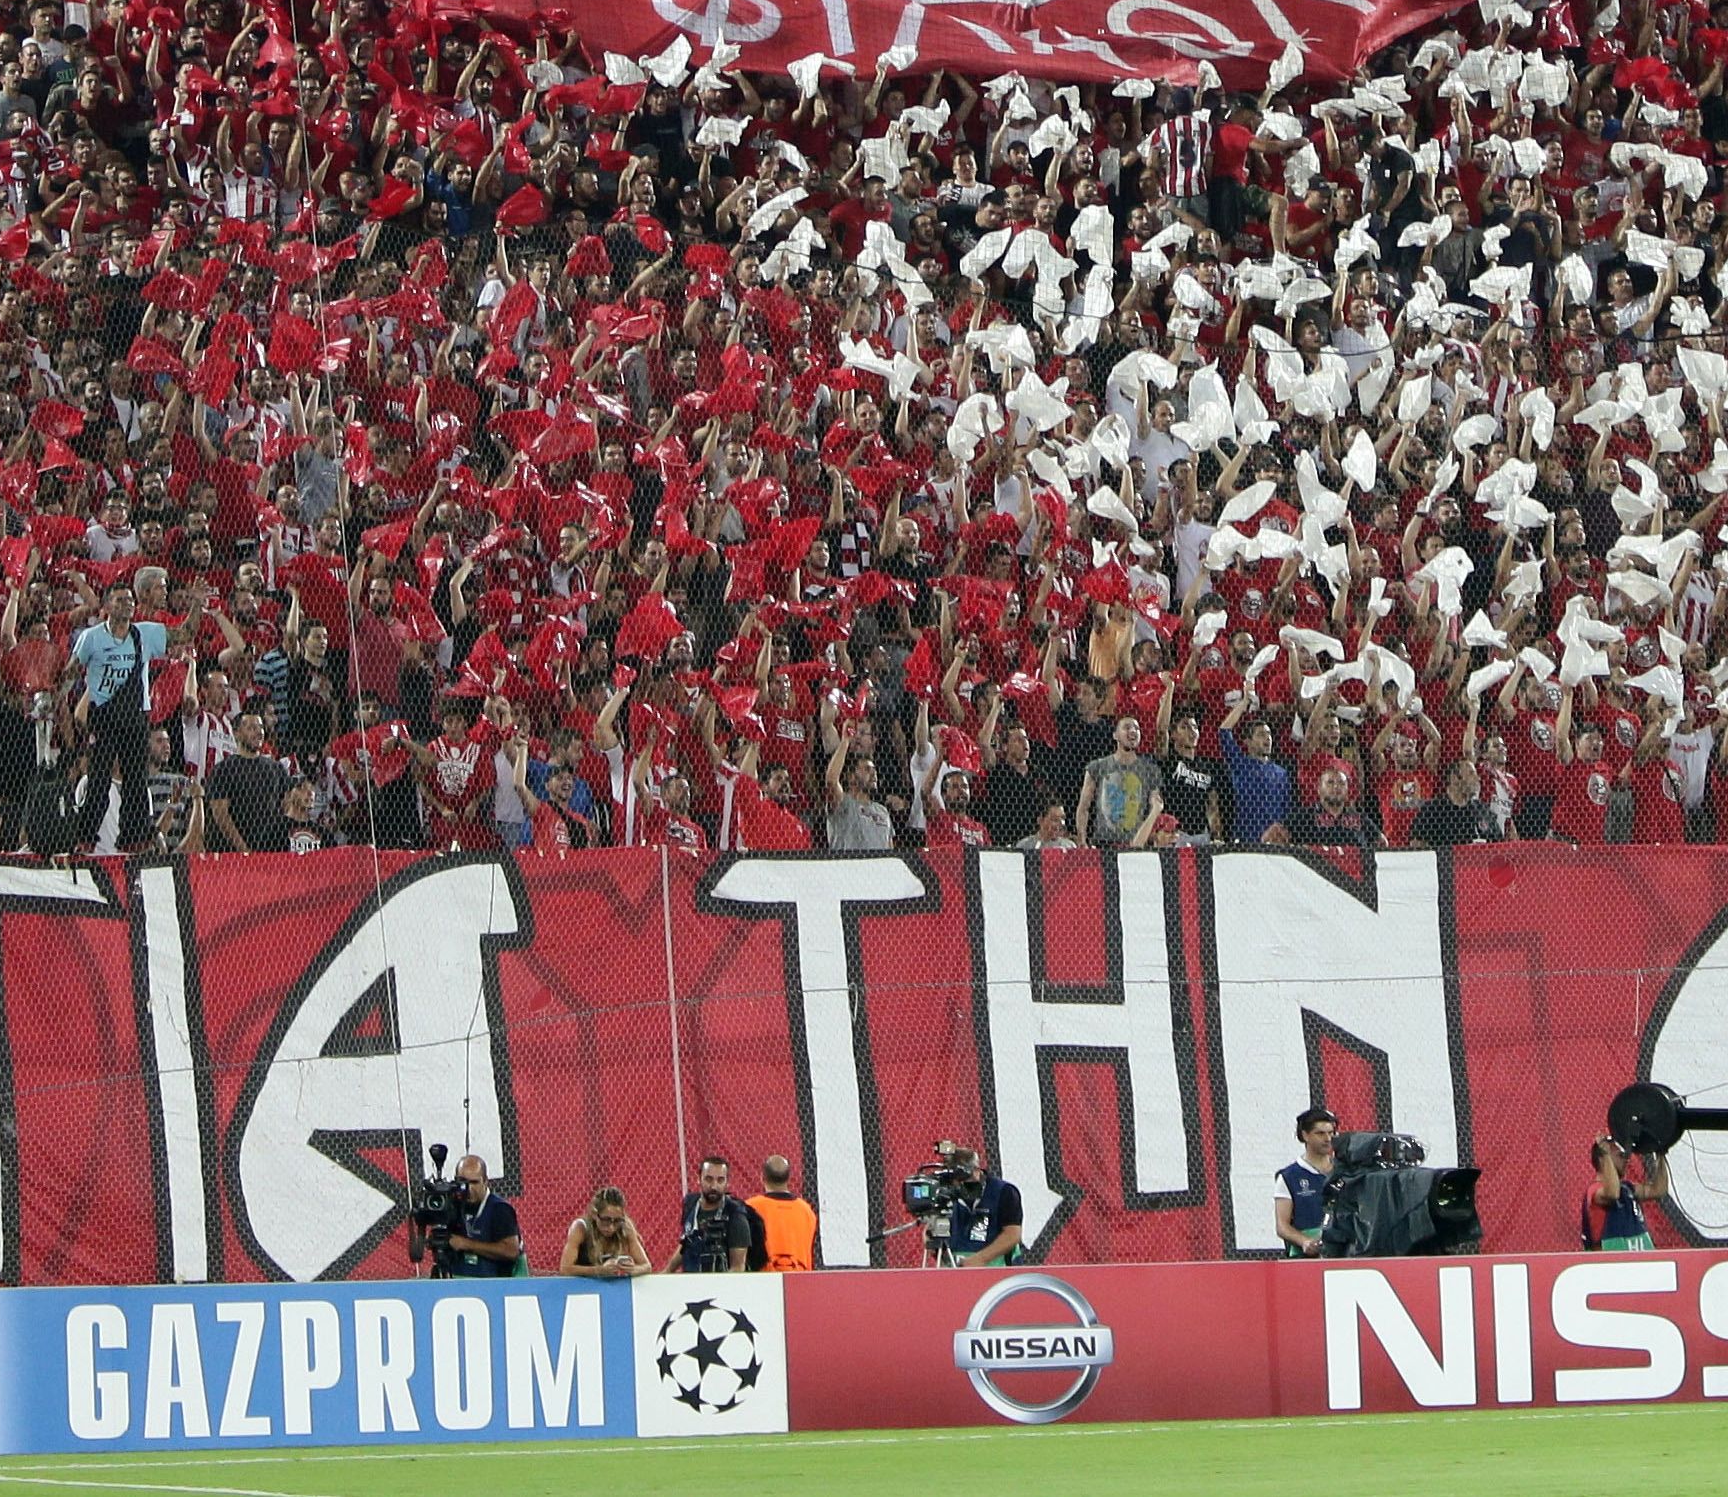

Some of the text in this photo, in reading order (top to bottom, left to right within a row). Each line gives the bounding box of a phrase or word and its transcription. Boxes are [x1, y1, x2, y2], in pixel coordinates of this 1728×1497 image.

[697, 847, 1474, 1265] ΤΗΝ
[66, 1293, 607, 1440] GAZPROM
[969, 1335, 1098, 1361] NISSAN
